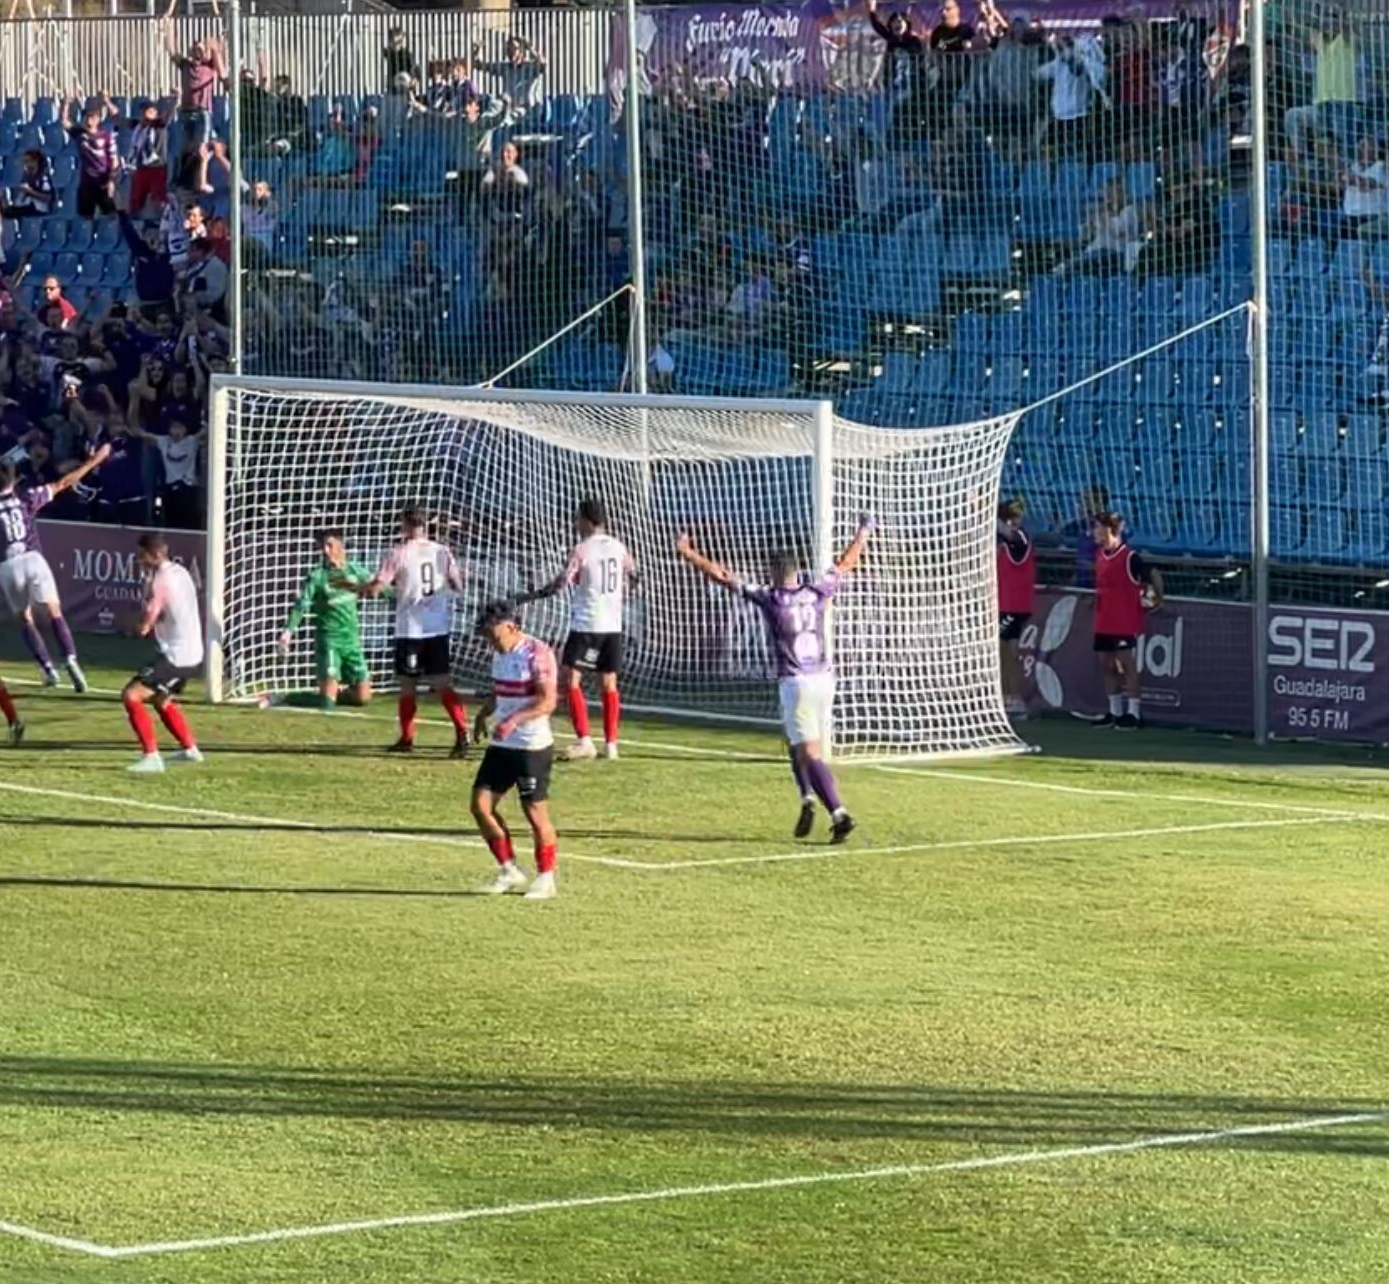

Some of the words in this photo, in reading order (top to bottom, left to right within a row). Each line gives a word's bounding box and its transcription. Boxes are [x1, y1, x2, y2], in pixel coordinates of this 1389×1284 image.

[0, 508, 27, 542] 18
[421, 561, 436, 597] 9
[601, 557, 619, 595] 16
[1267, 615, 1376, 673] SER
[1273, 674, 1367, 704] Guadalajara
[1323, 709, 1349, 731] FM
